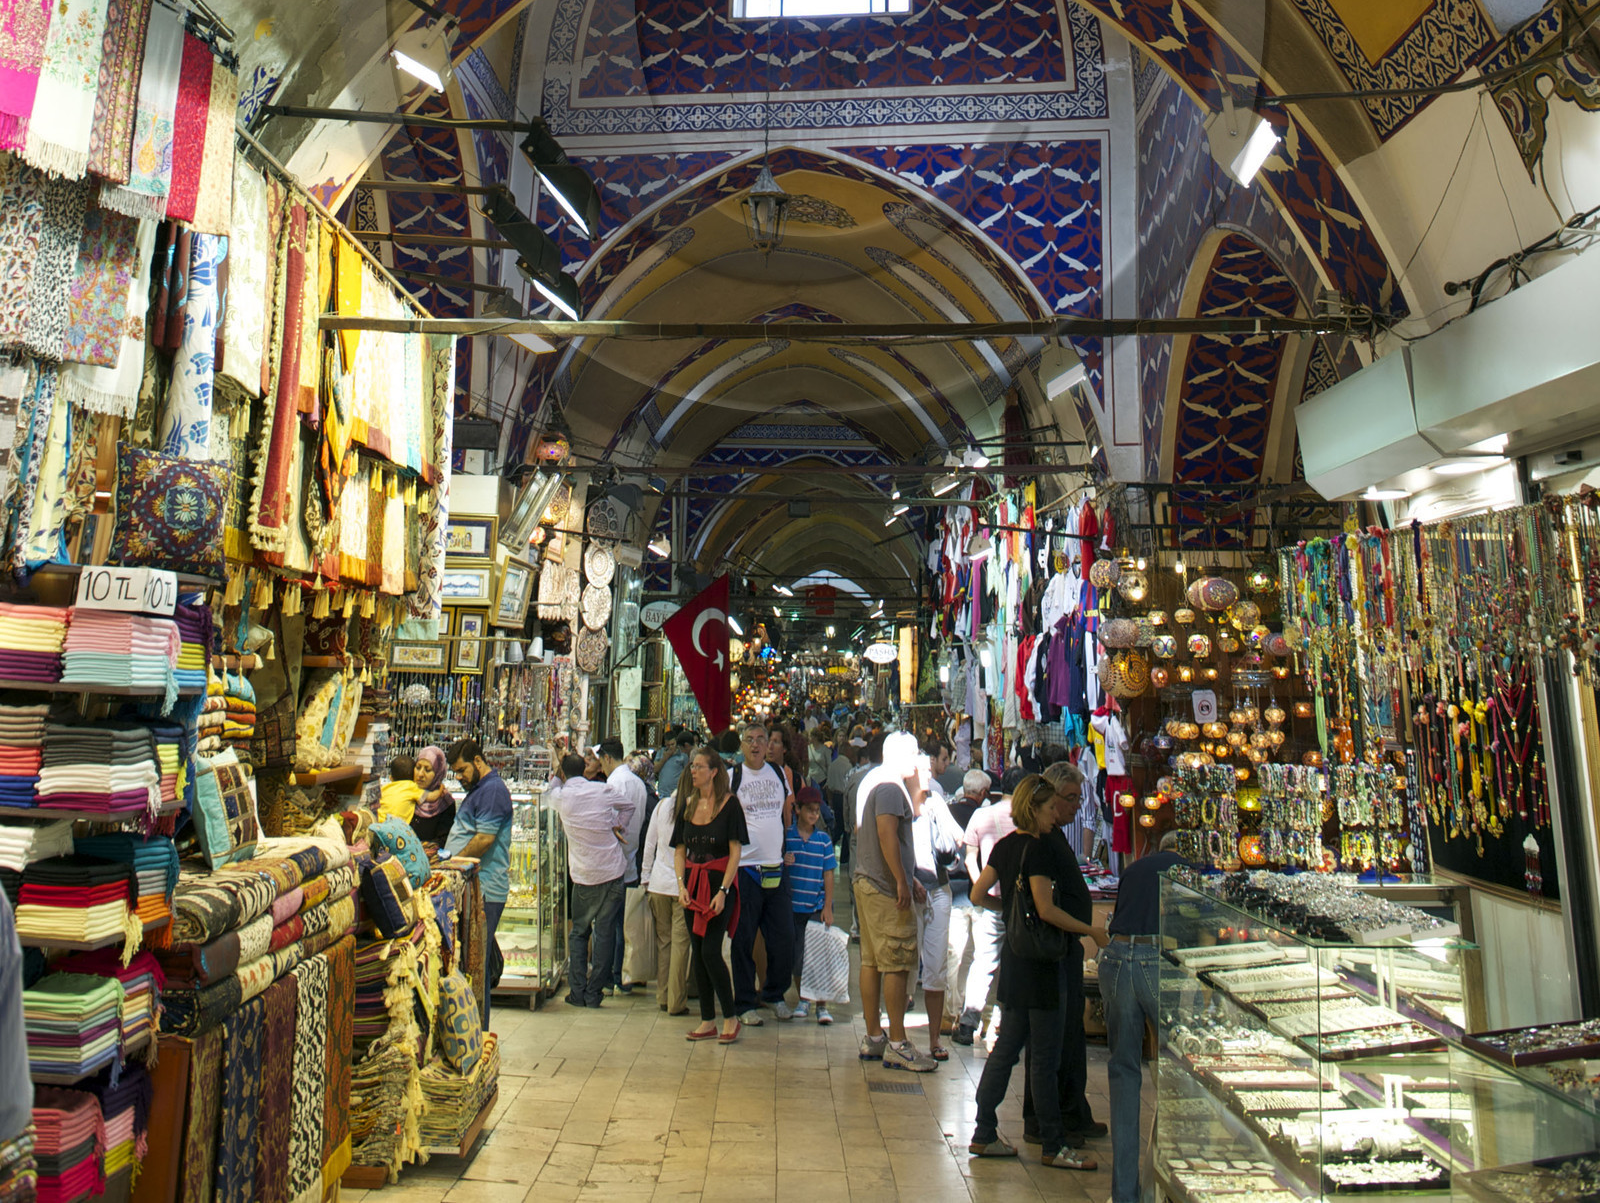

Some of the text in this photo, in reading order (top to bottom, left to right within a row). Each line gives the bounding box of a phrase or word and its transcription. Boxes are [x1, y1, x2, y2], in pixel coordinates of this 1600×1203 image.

[83, 571, 137, 601] 10 TL
[146, 576, 174, 609] 10 TL
